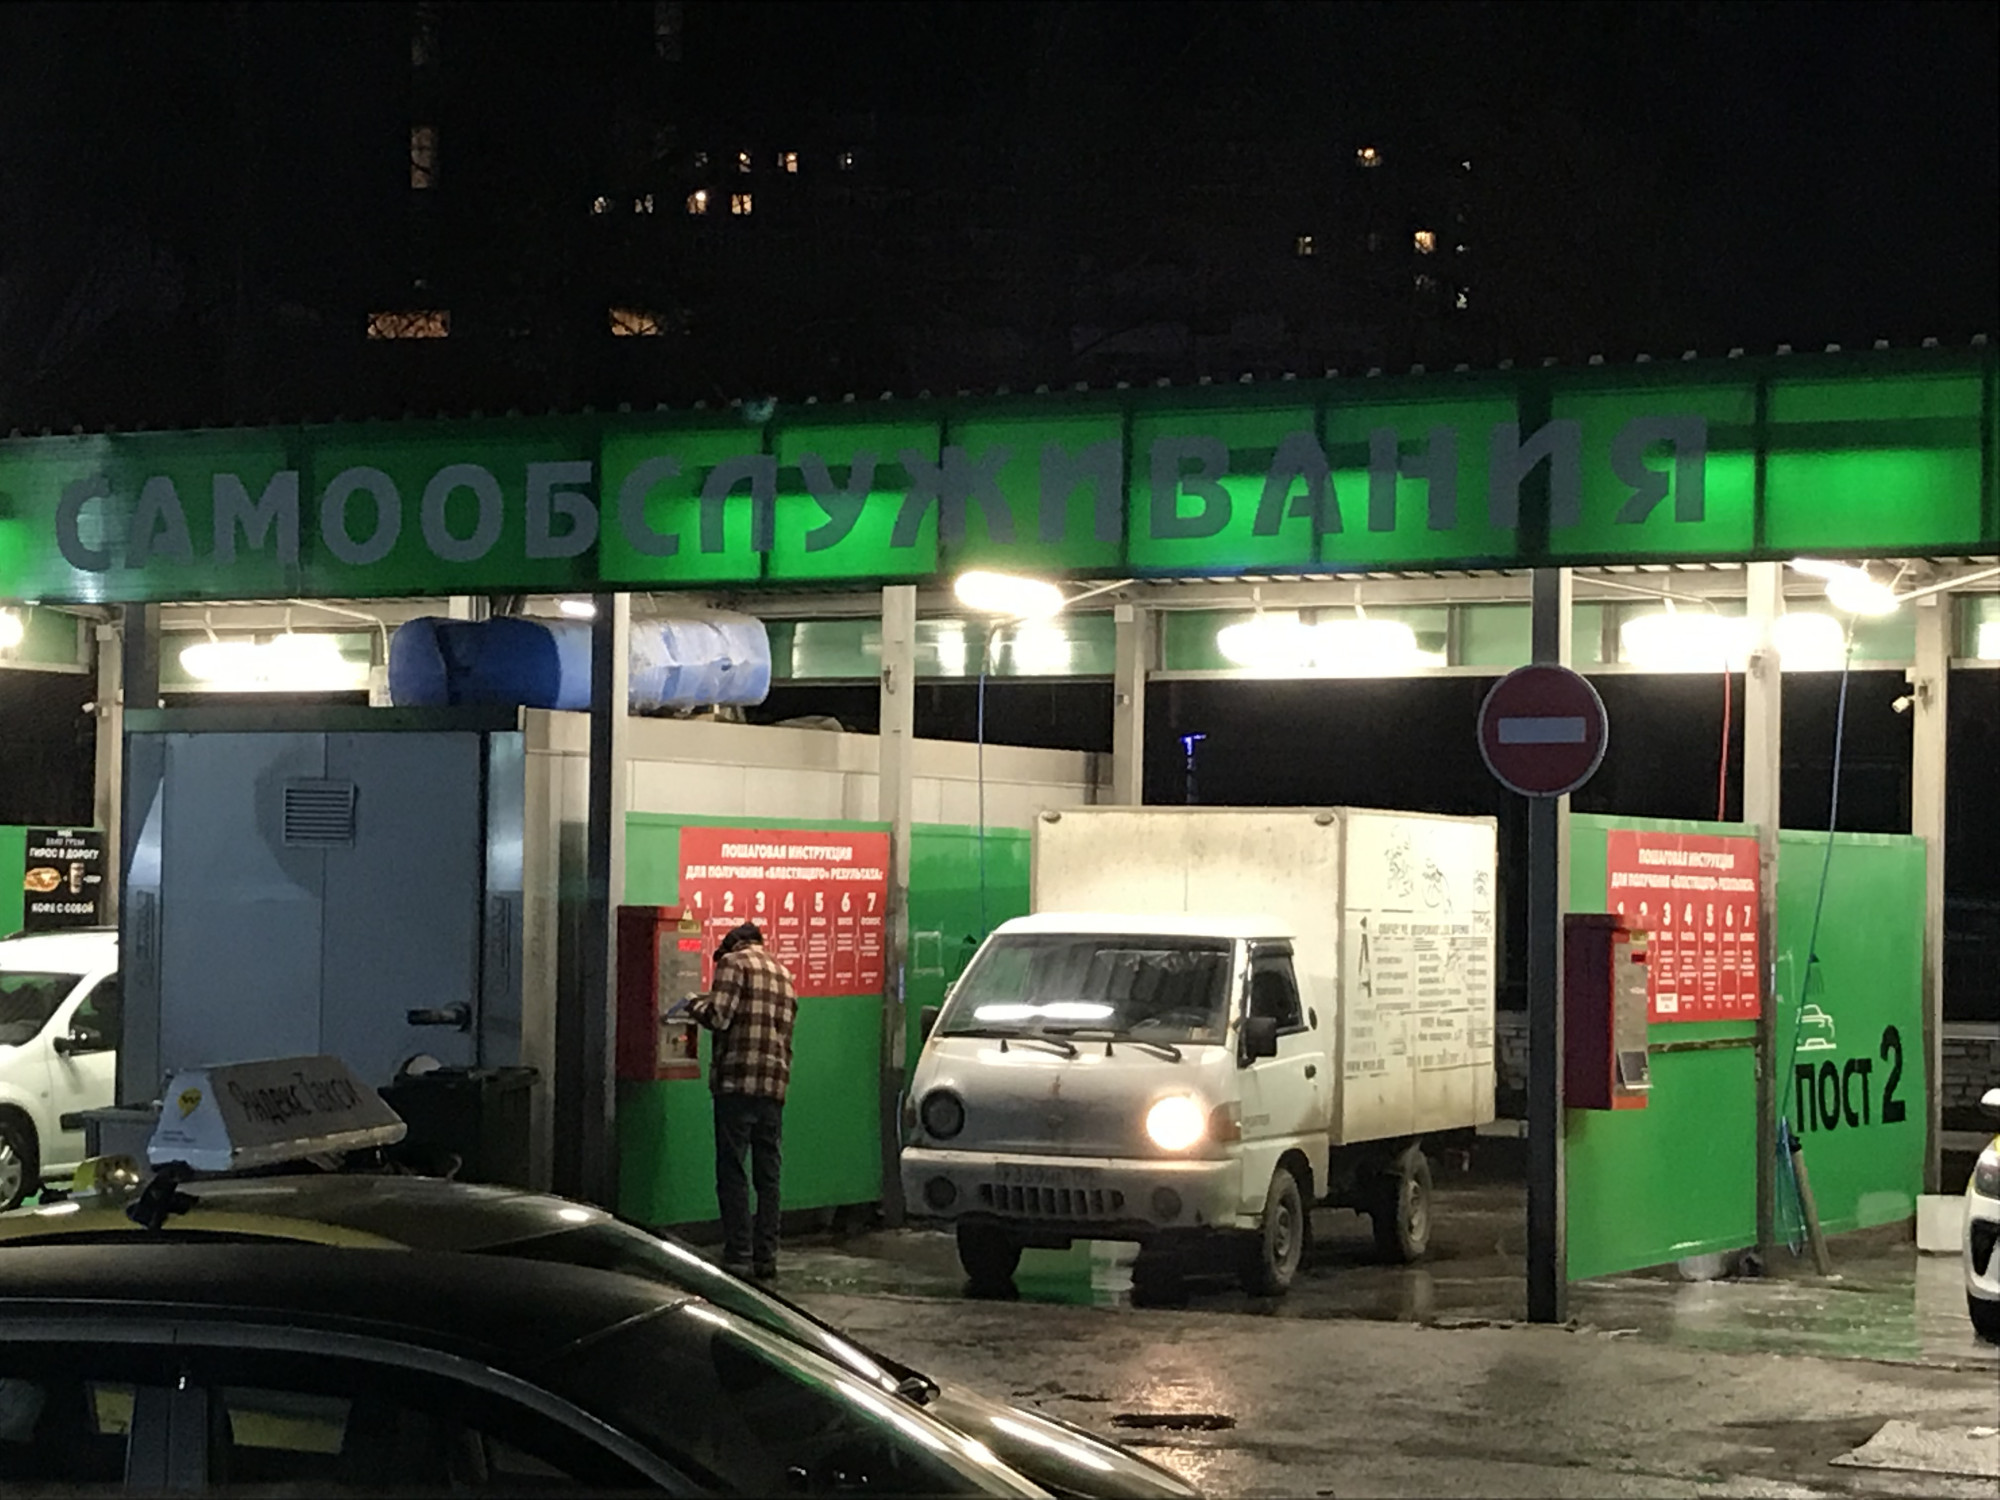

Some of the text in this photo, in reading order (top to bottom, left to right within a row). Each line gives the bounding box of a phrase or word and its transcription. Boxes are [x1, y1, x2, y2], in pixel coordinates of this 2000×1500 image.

[55, 415, 1708, 572] САМООБСЛУЖИВАНИЯ
[721, 843, 853, 862] ПОШАГОВАЯ ИНСТРУКЦИЯ
[685, 865, 707, 880] ДЛЯ
[64, 900, 94, 913] СОБОЙ
[724, 891, 734, 912] 2
[755, 891, 765, 913] 3
[784, 892, 794, 912] 4
[815, 892, 824, 912] 5
[841, 892, 850, 912] 6
[867, 892, 876, 912] 7
[1663, 901, 1671, 926] 3
[1684, 903, 1692, 926] 4
[1706, 903, 1714, 927] 5
[1726, 904, 1733, 927] 6
[1744, 905, 1751, 927] 7
[1795, 1025, 1906, 1132] ПОСТ 2
